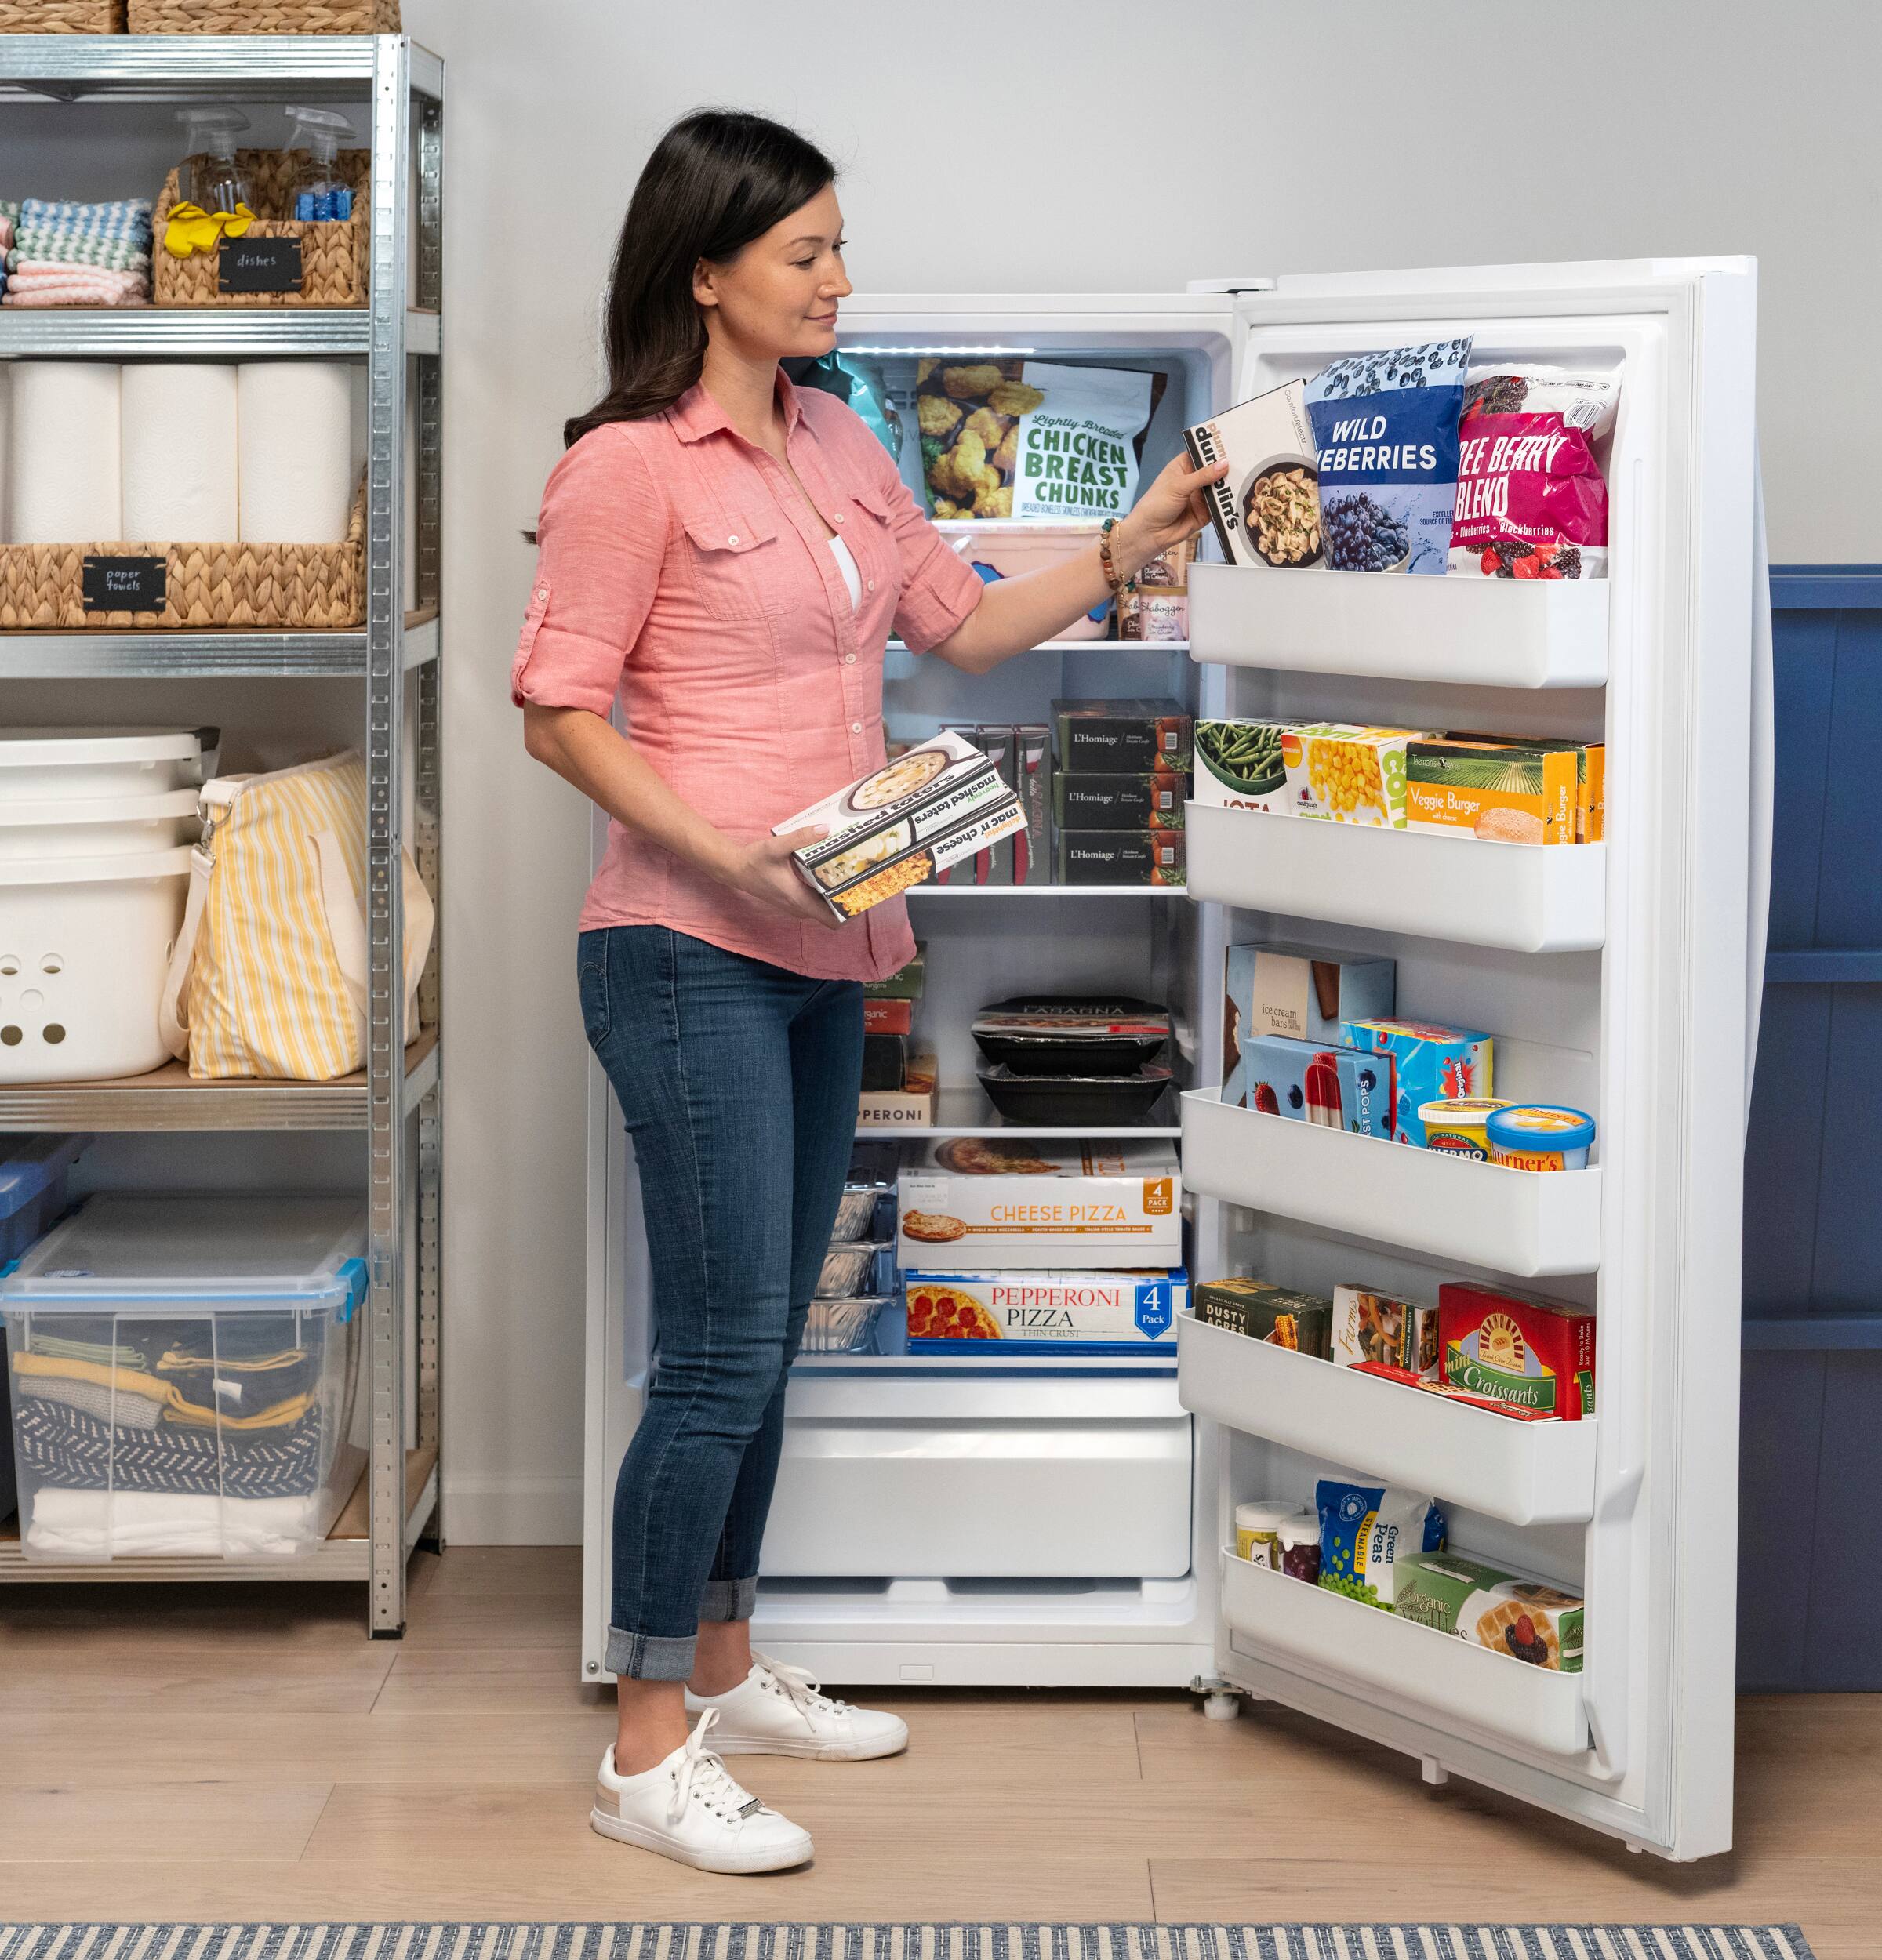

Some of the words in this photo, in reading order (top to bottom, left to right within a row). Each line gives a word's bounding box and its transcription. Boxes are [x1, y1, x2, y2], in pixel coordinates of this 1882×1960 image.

[237, 254, 277, 267] dishes
[1032, 415, 1080, 430] Lightly
[1081, 420, 1128, 439] Breaded
[1332, 416, 1386, 442] WILD
[1027, 428, 1126, 465] CHICKEN
[1206, 423, 1227, 460] plum
[1487, 433, 1568, 474] BERRY
[1025, 452, 1128, 488] BREAST
[1317, 445, 1437, 472] EBERRIES
[1035, 481, 1120, 510] CHUNKS
[1455, 474, 1510, 523] BLEND
[1460, 523, 1490, 539] Blueberries
[1500, 521, 1554, 537] Blackberries
[107, 571, 141, 583] paper
[107, 579, 140, 590] towels
[1074, 733, 1119, 746] L'Homiage
[950, 775, 997, 807] mashed
[1069, 793, 1114, 804] L'Homiage
[1411, 786, 1444, 811] Veggie
[1447, 791, 1481, 815] Burger
[914, 800, 951, 824] taters
[1555, 785, 1568, 822] Burger
[804, 810, 889, 858] mashed
[891, 774, 956, 811] taters
[984, 815, 1021, 839] delightful
[991, 808, 1019, 826] mac
[1432, 811, 1441, 820] with
[1442, 811, 1458, 822] cheese
[936, 829, 979, 855] cheese
[1070, 850, 1115, 862] L'Homiage
[1263, 1004, 1273, 1014] ice
[1273, 1008, 1297, 1019] cream
[1271, 1016, 1288, 1029] bars
[1454, 1062, 1466, 1098] Original
[1361, 1080, 1370, 1115] POPS
[1441, 1133, 1470, 1143] NATURAL
[1152, 1183, 1162, 1196] 4
[990, 1205, 1066, 1221] CHEESE
[1070, 1206, 1127, 1221] PIZZA
[991, 1287, 1121, 1307] PEPPERONI
[1143, 1287, 1161, 1311] 4
[1209, 1295, 1232, 1305] ORGANICALLY
[1008, 1308, 1074, 1327] PIZZA
[1143, 1314, 1164, 1324] Pack
[1206, 1304, 1246, 1325] DUSTY
[1207, 1317, 1245, 1335] ACRES
[1339, 1298, 1357, 1355] Farms
[1444, 1348, 1470, 1374] mini
[1464, 1367, 1539, 1406] Croissants
[1356, 1517, 1373, 1566] STEAMABLE
[1372, 1523, 1388, 1563] Peas
[1386, 1526, 1399, 1564] Green
[1408, 1592, 1451, 1614] organic
